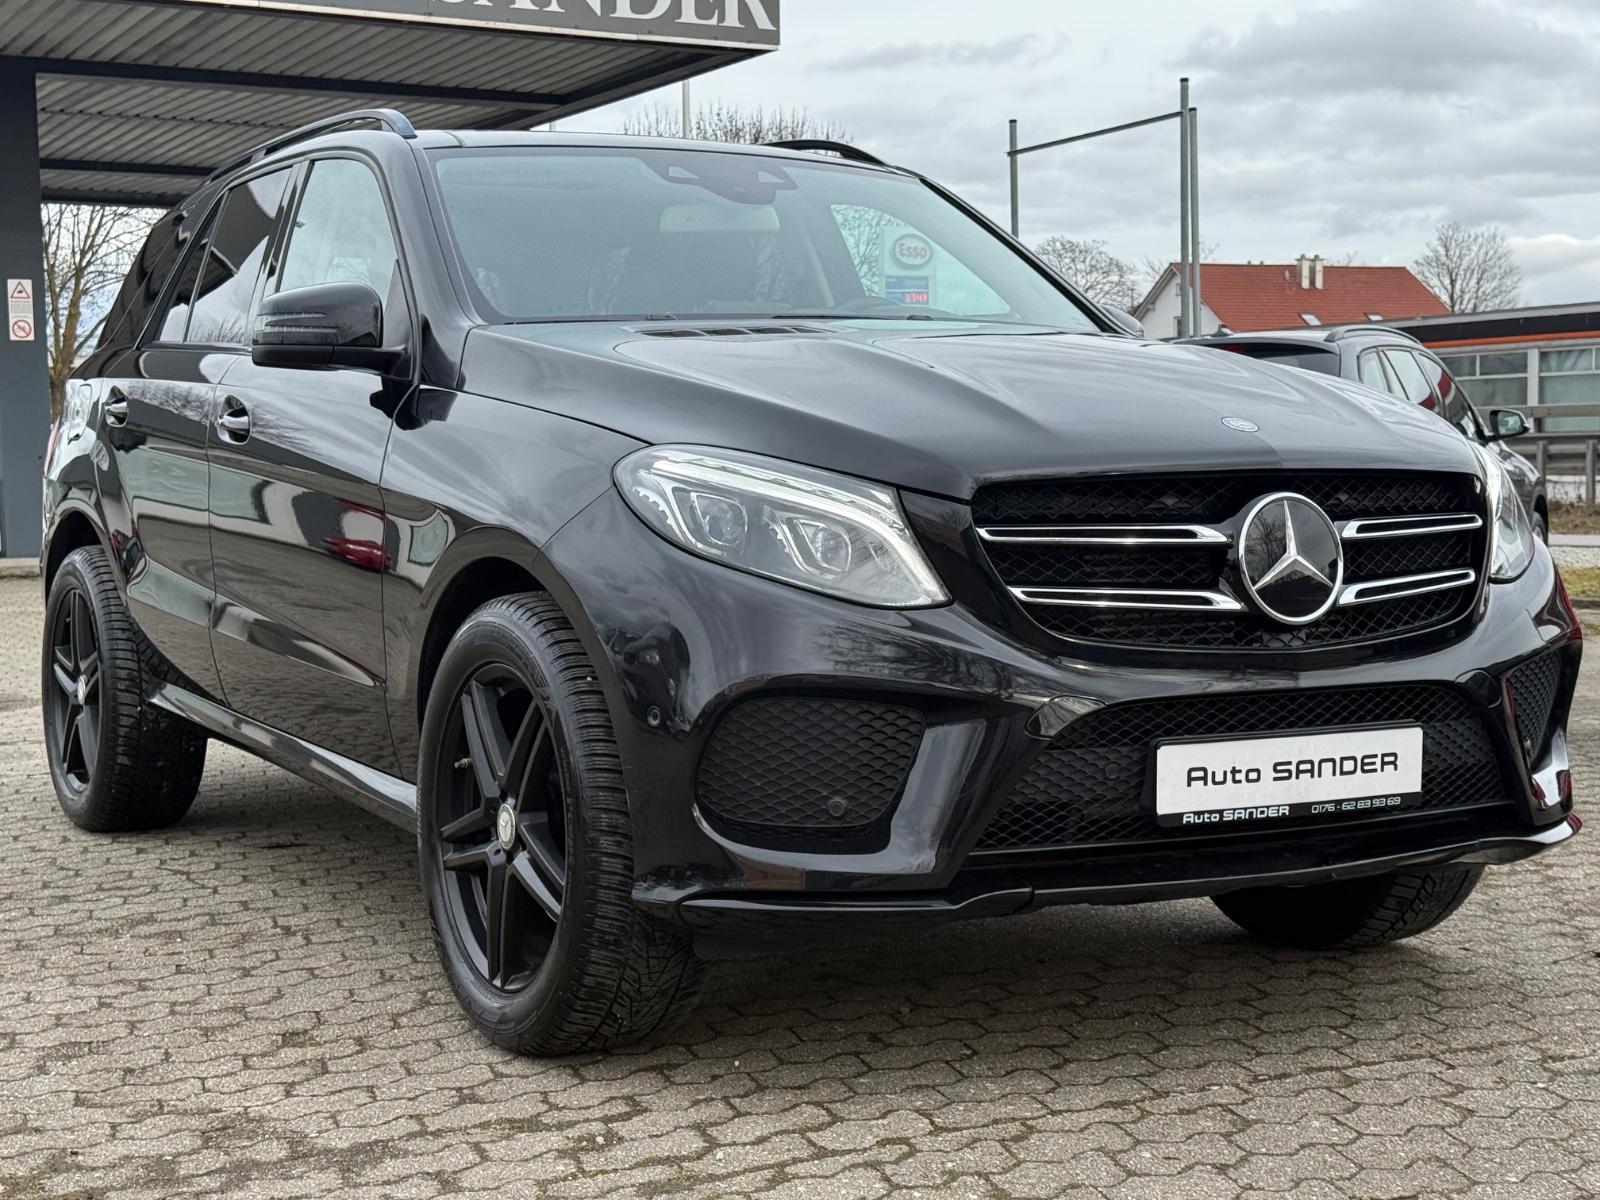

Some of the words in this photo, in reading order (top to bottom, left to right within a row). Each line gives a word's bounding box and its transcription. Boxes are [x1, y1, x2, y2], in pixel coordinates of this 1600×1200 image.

[898, 242, 928, 258] Esso
[1186, 766, 1262, 787] Auto
[1272, 752, 1399, 782] SANDER
[1311, 803, 1336, 814] 0176
[1341, 801, 1356, 811] 62
[1357, 799, 1371, 809] 83
[1372, 797, 1386, 807] 93
[1387, 796, 1402, 806] 69
[1182, 812, 1220, 825] Auto
[1223, 805, 1290, 821] SANDER
